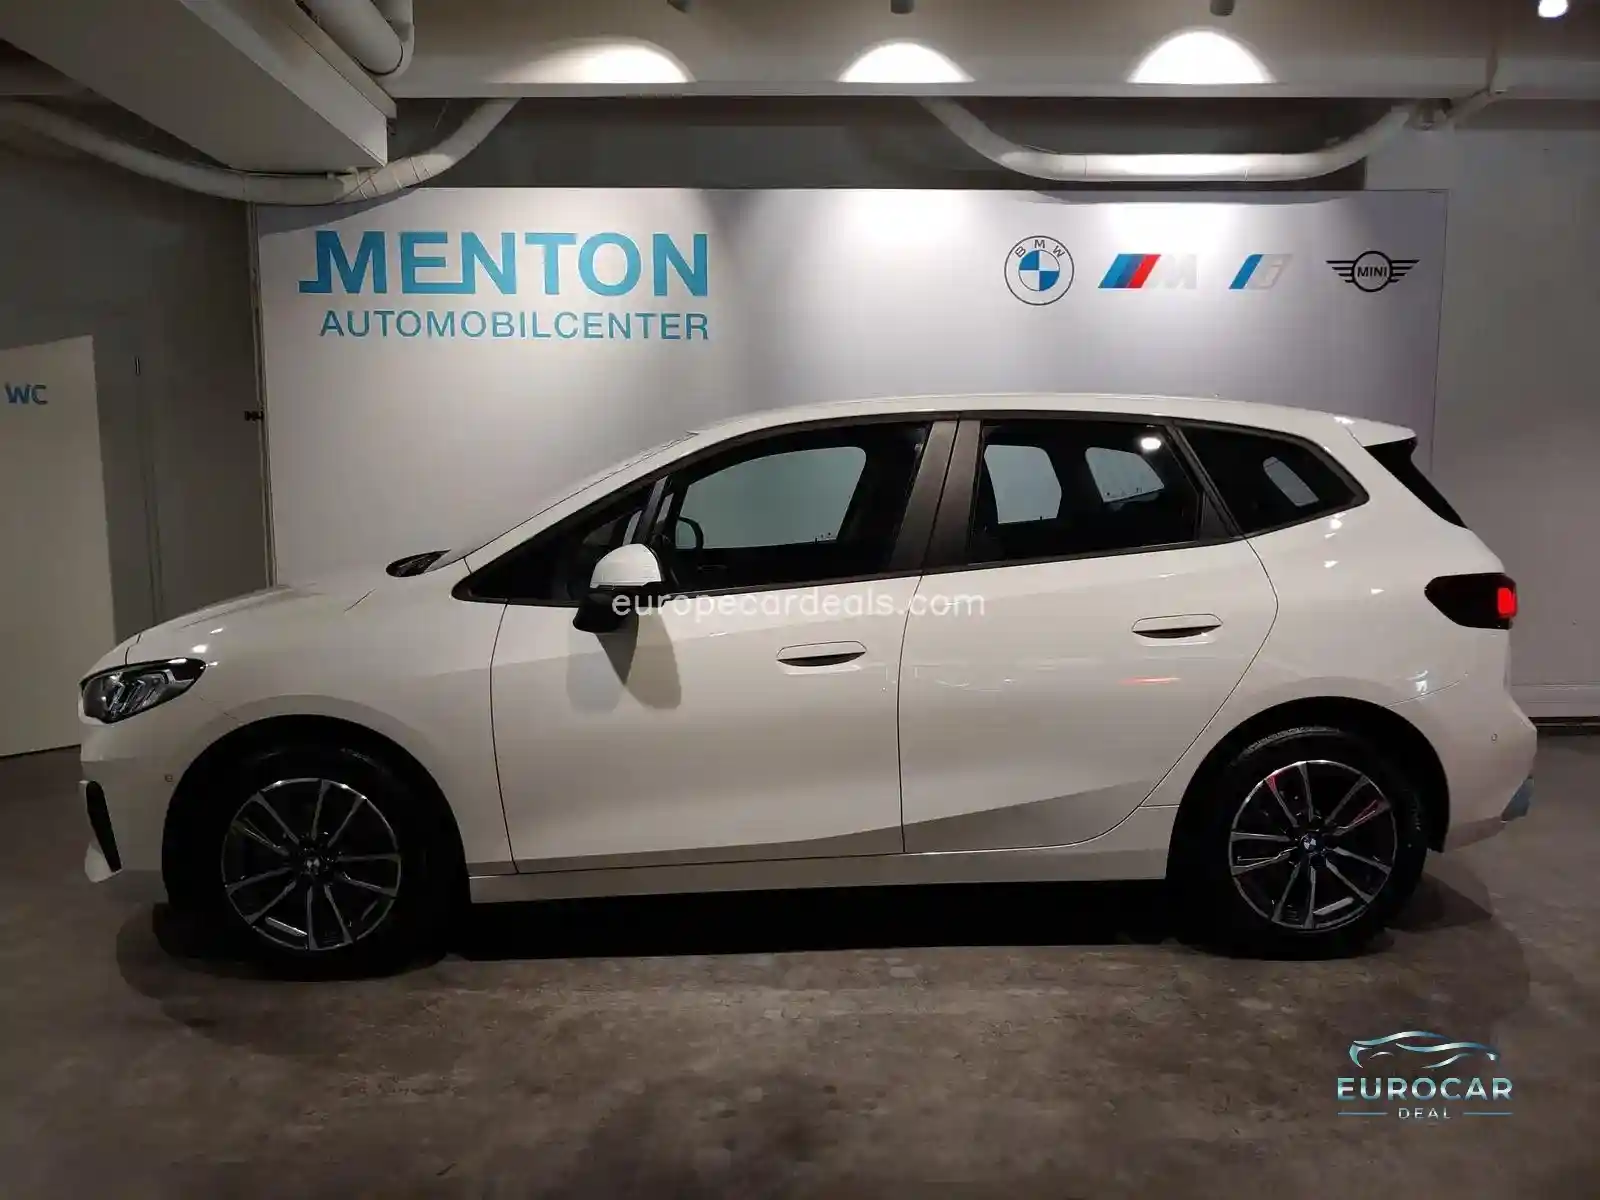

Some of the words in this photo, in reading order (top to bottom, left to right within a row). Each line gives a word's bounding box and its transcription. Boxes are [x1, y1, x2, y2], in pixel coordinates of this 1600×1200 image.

[1014, 239, 1066, 258] BMW
[299, 230, 709, 297] MENTON
[1357, 266, 1388, 278] MINI
[319, 310, 709, 340] AUTOMOBILCENTER
[4, 382, 48, 405] WC
